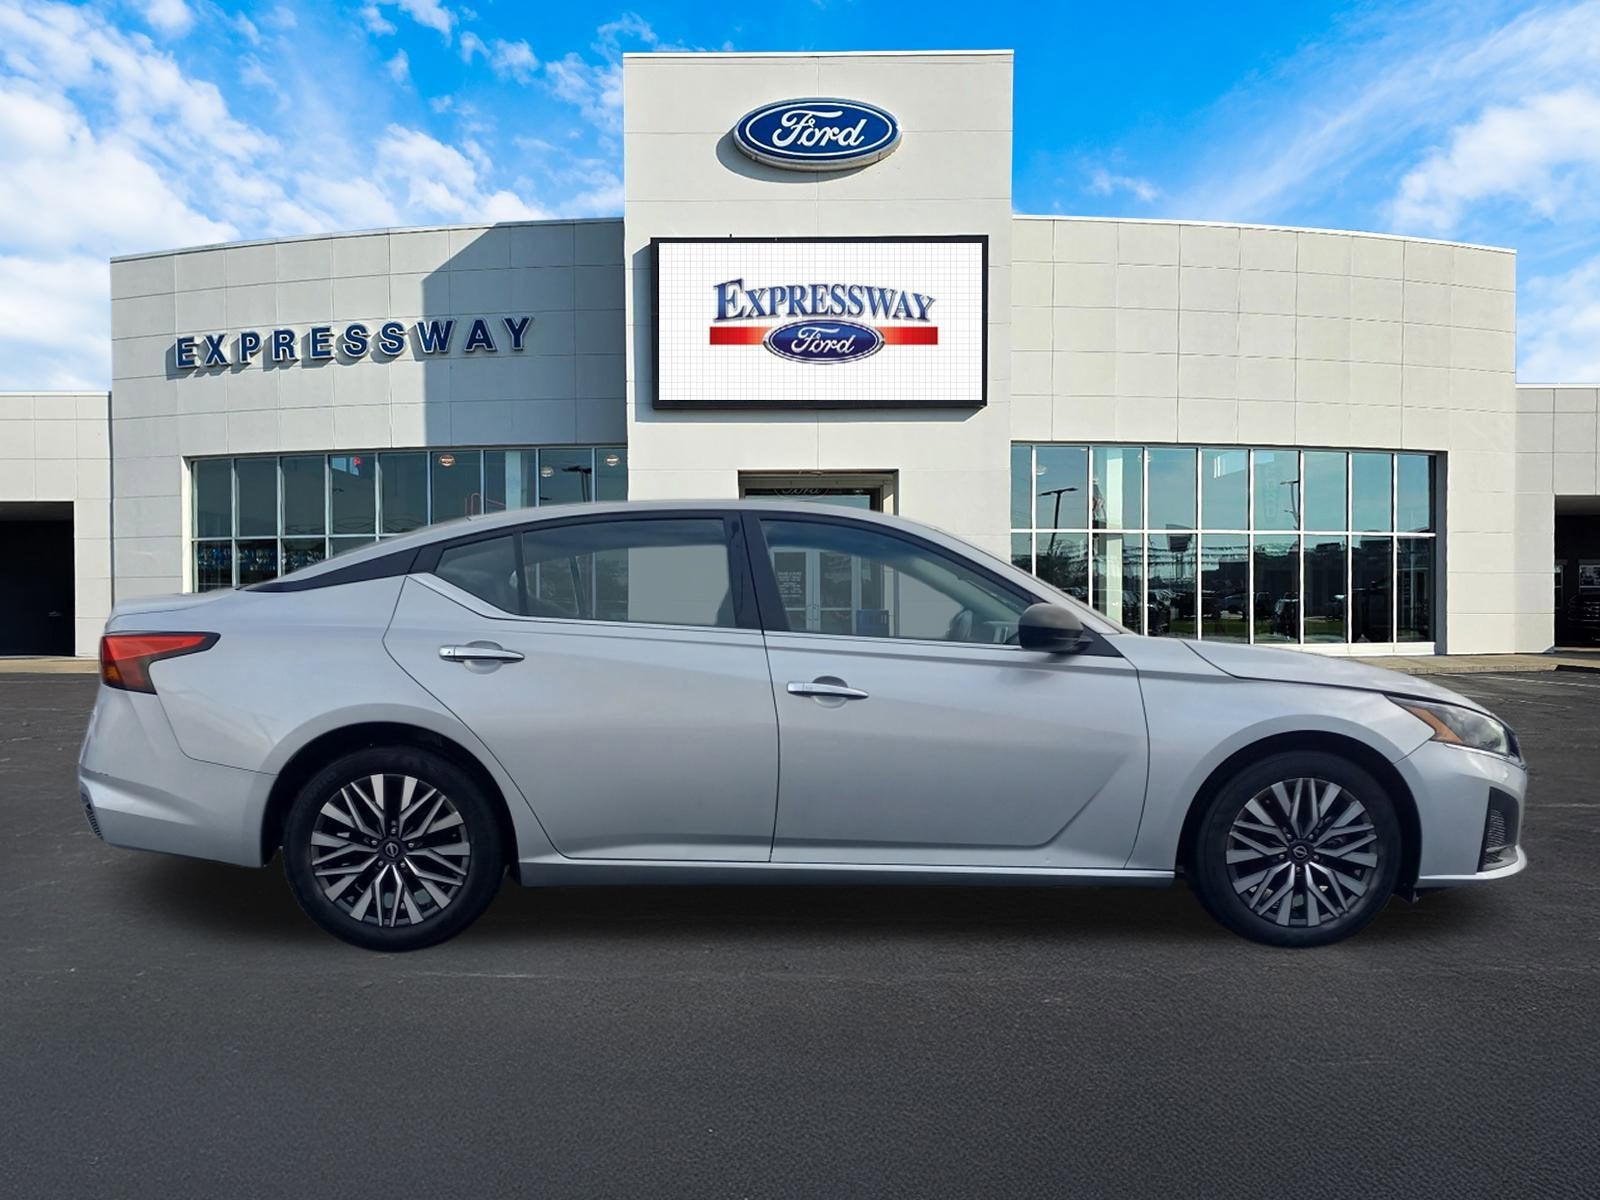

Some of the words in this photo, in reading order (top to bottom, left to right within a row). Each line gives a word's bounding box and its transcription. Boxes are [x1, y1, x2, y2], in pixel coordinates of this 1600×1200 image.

[772, 110, 867, 147] Ford
[713, 278, 936, 322] EXPRESSWAY
[175, 315, 533, 368] EXPRESSWAY
[791, 327, 854, 353] Ford
